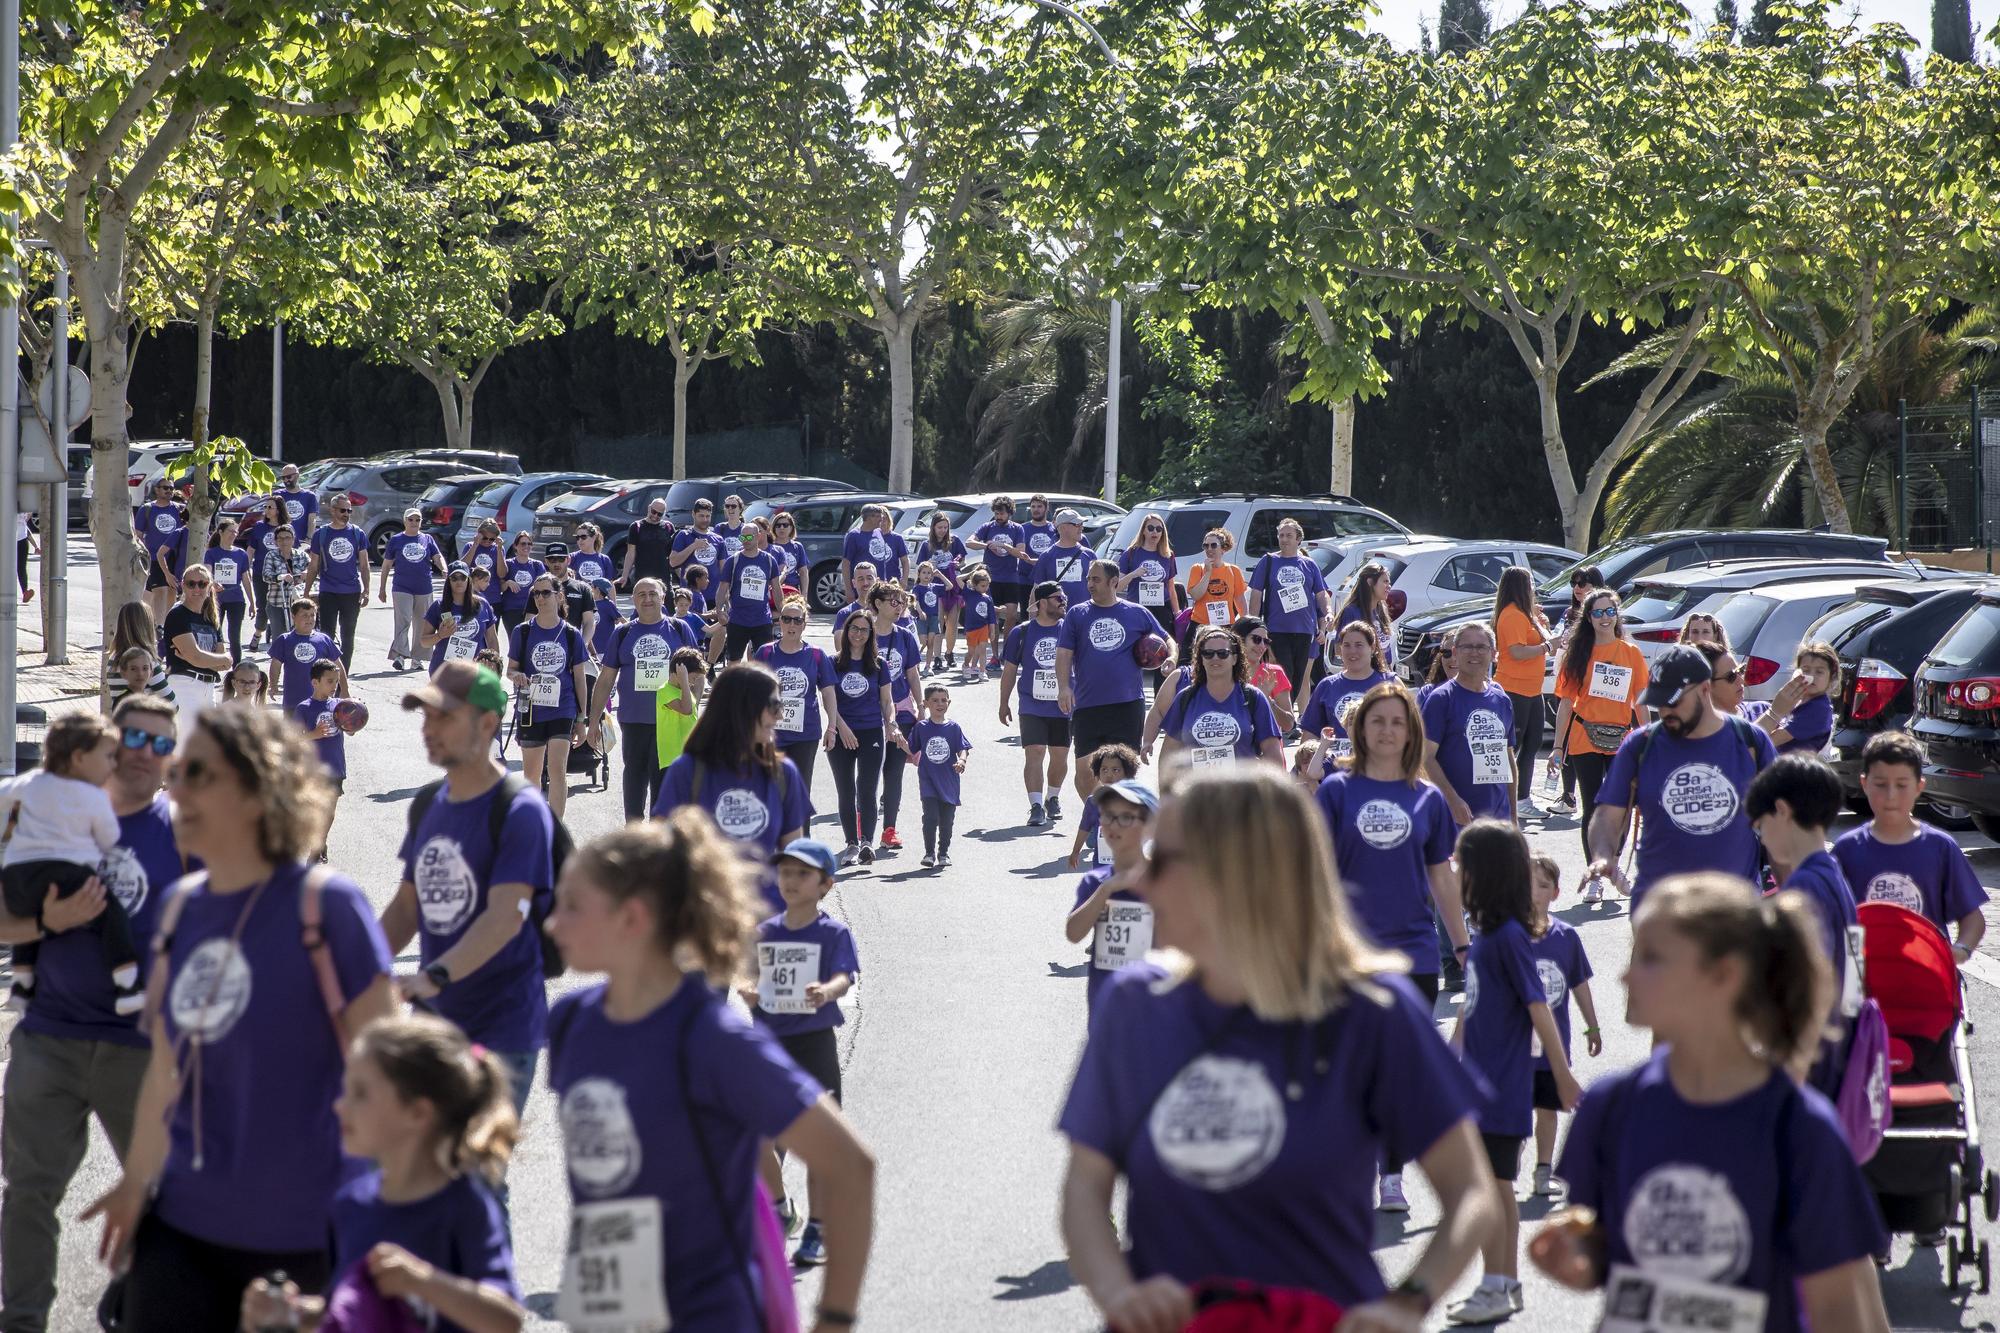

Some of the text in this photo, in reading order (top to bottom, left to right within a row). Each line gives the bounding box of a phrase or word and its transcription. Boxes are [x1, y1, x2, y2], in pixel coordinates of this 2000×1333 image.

[1288, 593, 1300, 602] 330
[454, 646, 468, 656] 230
[645, 670, 660, 679] 827
[1042, 680, 1057, 690] 759
[1603, 675, 1620, 687] 836
[538, 684, 552, 694] 766
[1473, 714, 1487, 724] 8a
[1484, 755, 1501, 766] 355
[1675, 772, 1700, 787] 8a
[1669, 785, 1712, 797] CURSA
[1104, 924, 1131, 944] 531
[772, 967, 797, 985] 461
